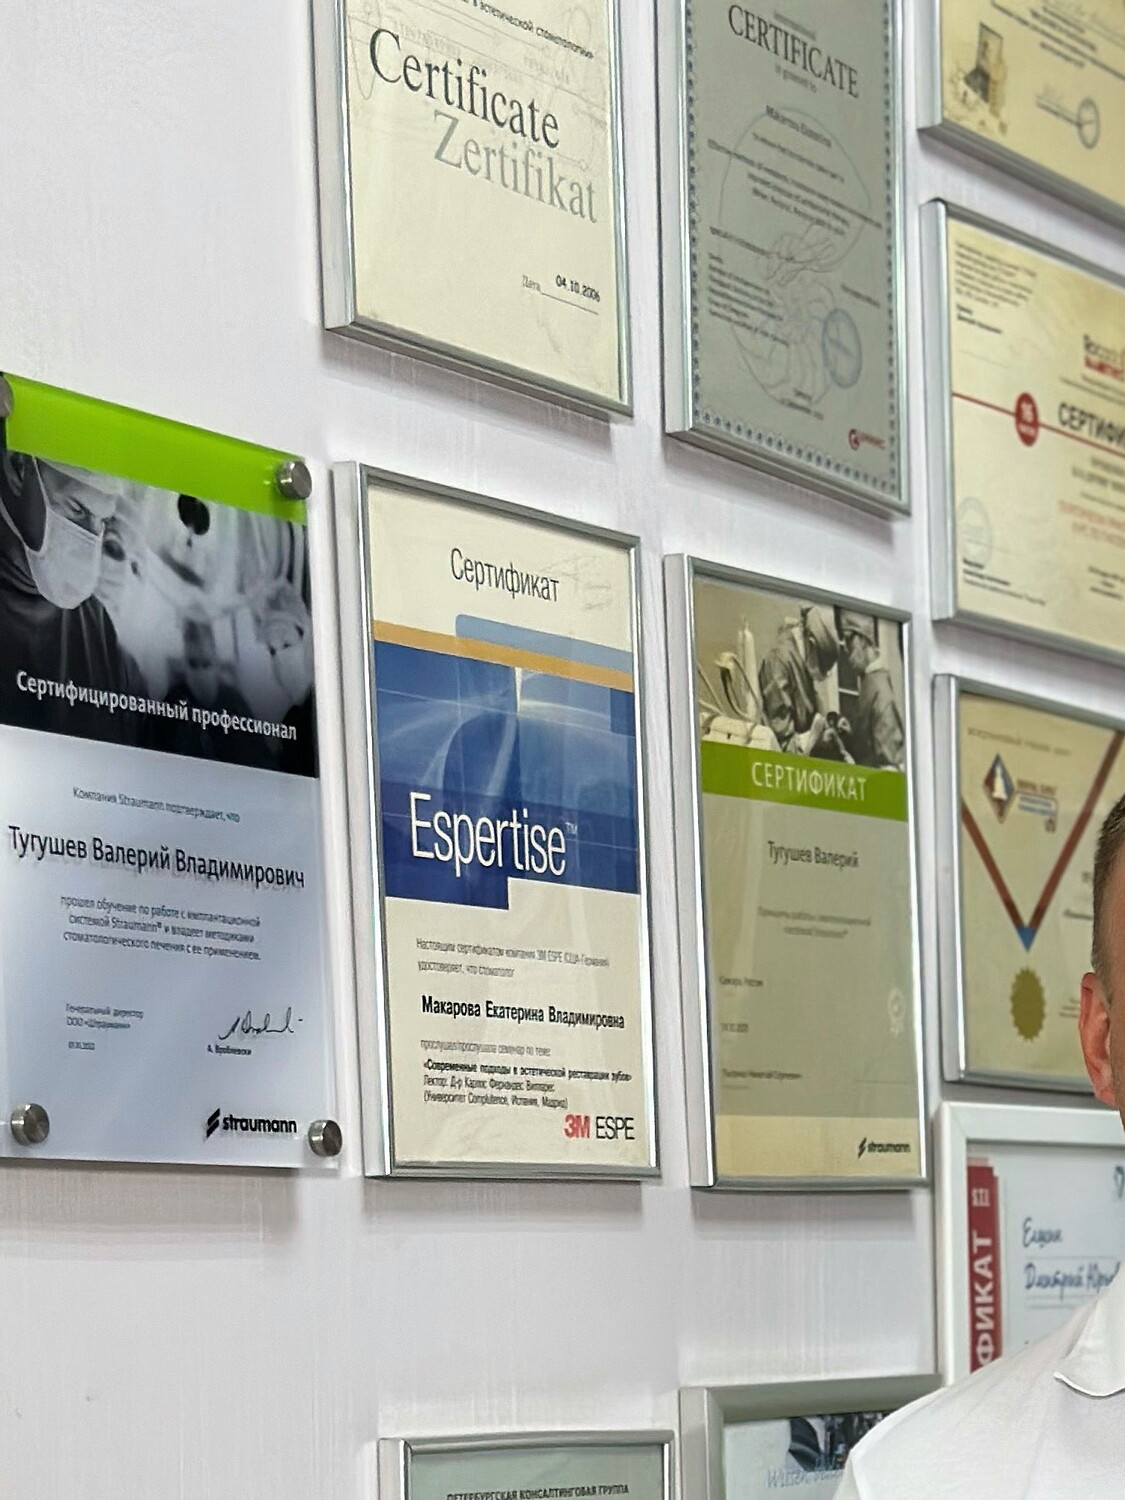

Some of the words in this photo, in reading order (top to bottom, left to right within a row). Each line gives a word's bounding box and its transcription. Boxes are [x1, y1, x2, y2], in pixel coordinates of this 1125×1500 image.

[728, 4, 859, 99] CERTIFICATE
[369, 28, 560, 149] Certificate
[433, 111, 598, 224] Zertifikat
[450, 547, 560, 602] Сертификат
[16, 669, 190, 721] Сертифицированный
[191, 707, 297, 741] профессионал
[751, 761, 867, 802] СЕРТИФИКАТ
[8, 825, 88, 861] Тугушев
[92, 836, 171, 874] Валерий
[175, 849, 305, 890] Владимирович
[767, 840, 812, 867] Тугушев
[814, 845, 860, 869] Валерий
[421, 995, 481, 1019] Макарова
[485, 1000, 544, 1024] Екатерина
[548, 1005, 626, 1030] Владимировна
[222, 1113, 298, 1134] straumann
[563, 1113, 591, 1139] 3M
[595, 1115, 636, 1140] ESPE
[867, 1140, 912, 1154] straumann
[519, 1485, 597, 1500] КОНСАЛТИНГОВАЯ
[598, 1484, 630, 1496] ГРУППА
